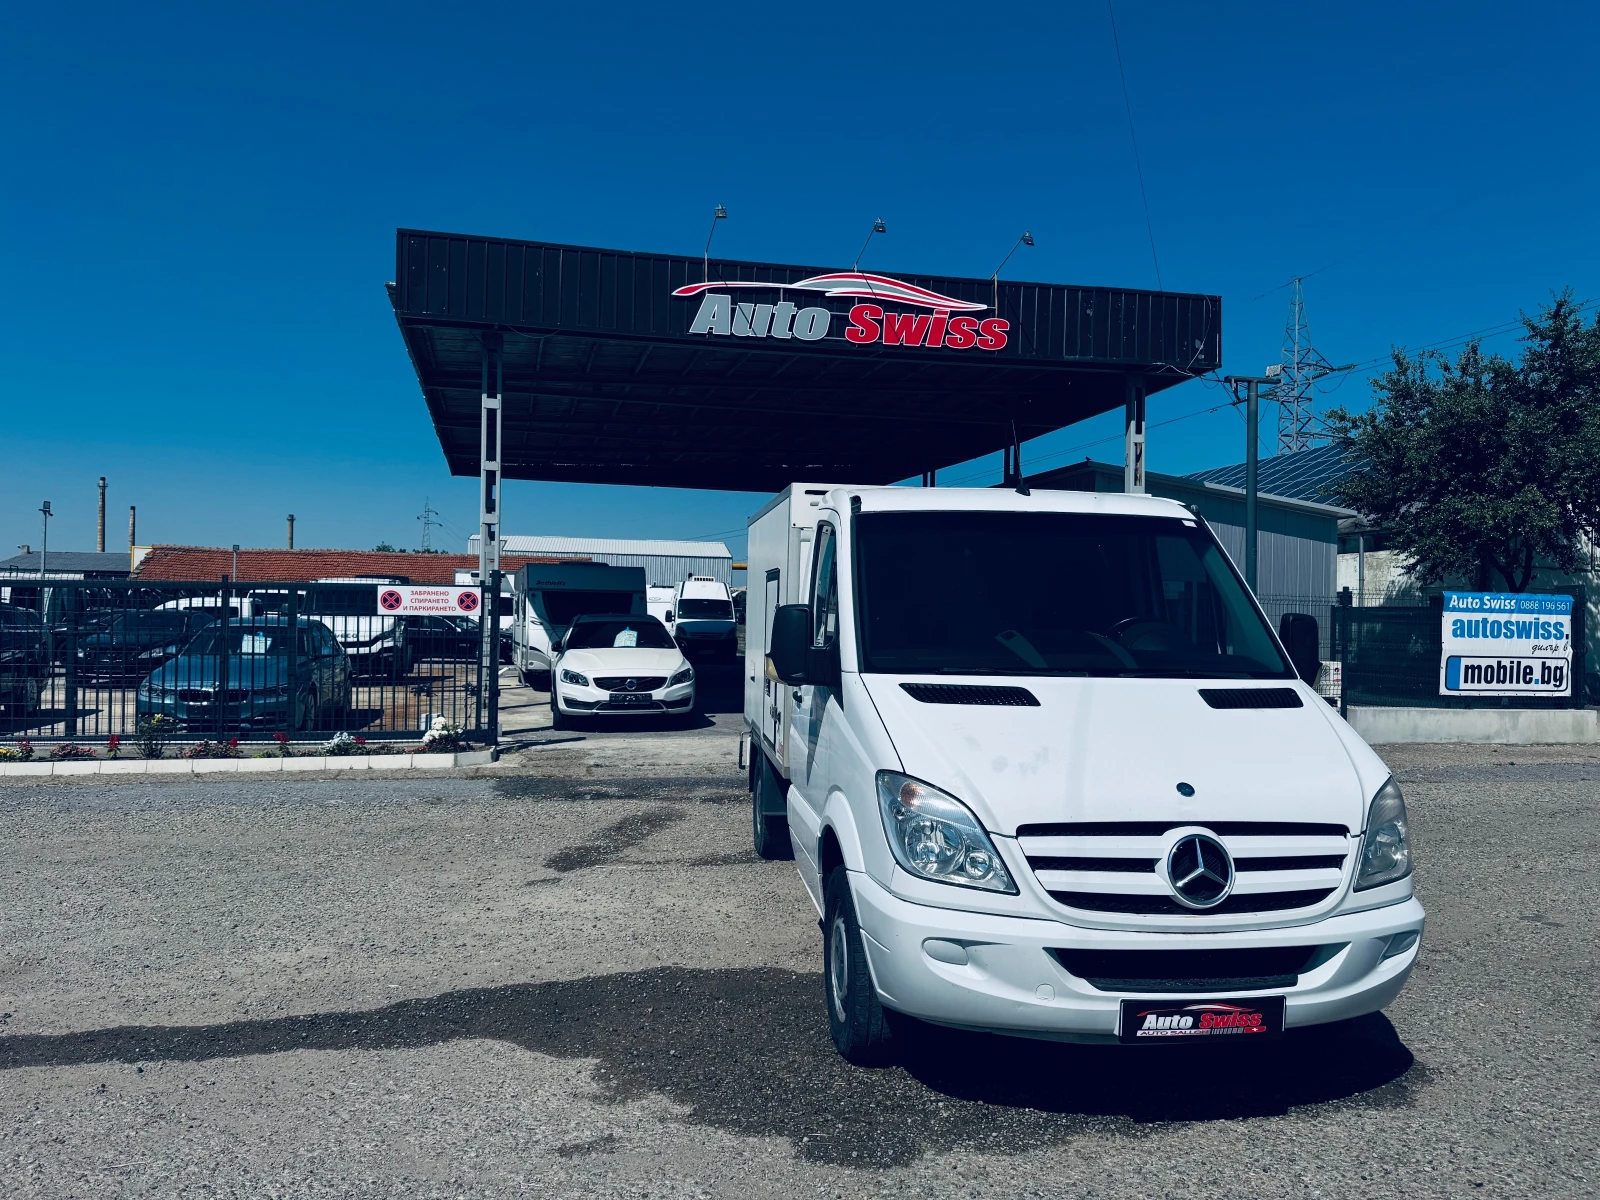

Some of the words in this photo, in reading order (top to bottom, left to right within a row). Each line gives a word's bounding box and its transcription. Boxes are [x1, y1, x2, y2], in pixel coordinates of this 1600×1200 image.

[689, 294, 831, 340] Auto
[845, 303, 1010, 350] Swiss
[1449, 595, 1480, 609] Auto
[1483, 595, 1517, 610] Swiss
[1541, 601, 1556, 610] 196
[1556, 602, 1570, 611] 561
[1463, 660, 1565, 687] mobile.bg
[1142, 1014, 1194, 1030] Auto
[1199, 1012, 1262, 1028] Swiss
